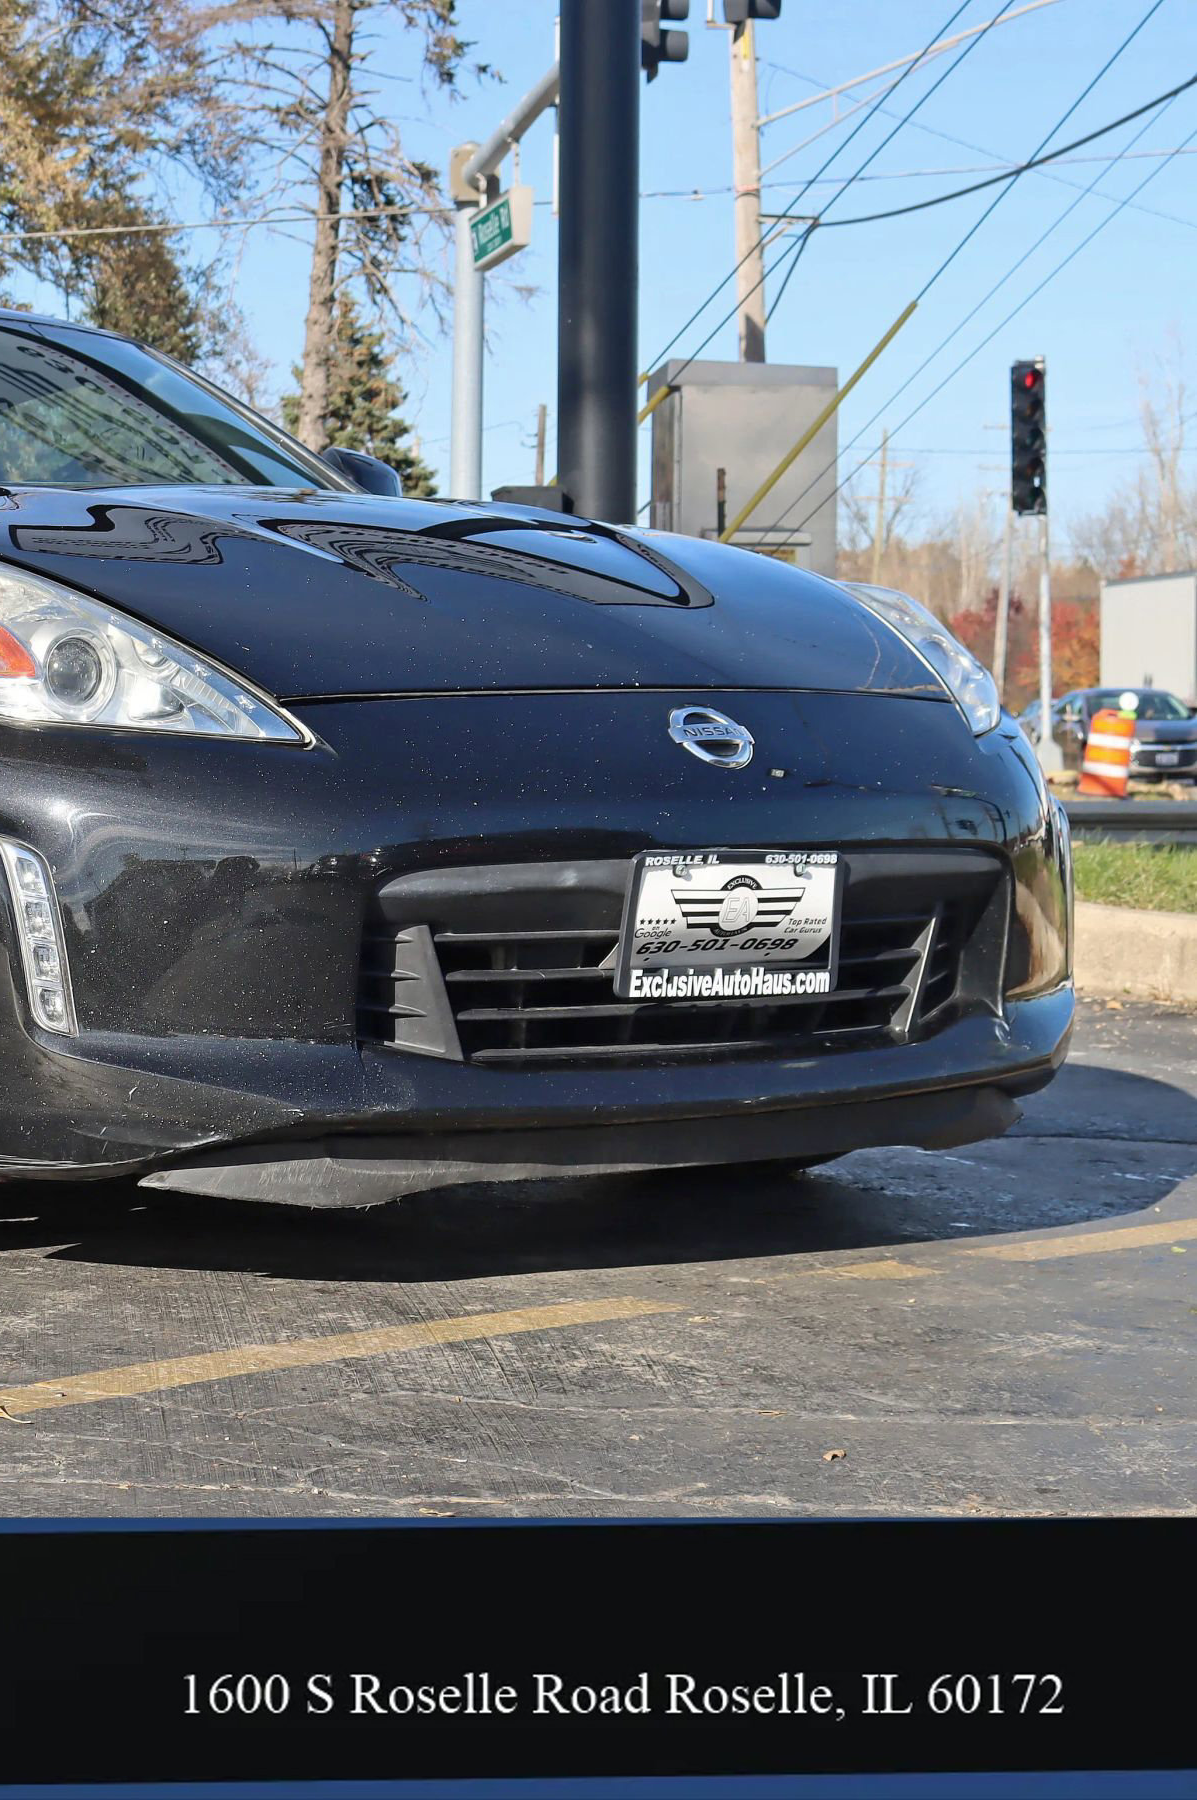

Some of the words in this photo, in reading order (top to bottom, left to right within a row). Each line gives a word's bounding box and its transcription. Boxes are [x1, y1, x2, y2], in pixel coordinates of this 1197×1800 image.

[707, 854, 720, 865] IL
[765, 854, 838, 865] 630-501-0698
[721, 897, 751, 923] EA
[788, 917, 803, 927] Top
[803, 917, 828, 925] Rated
[634, 927, 672, 940] Google
[635, 938, 799, 955] 630-501-0698
[629, 966, 830, 998] ExclusiveAutoHaus.com
